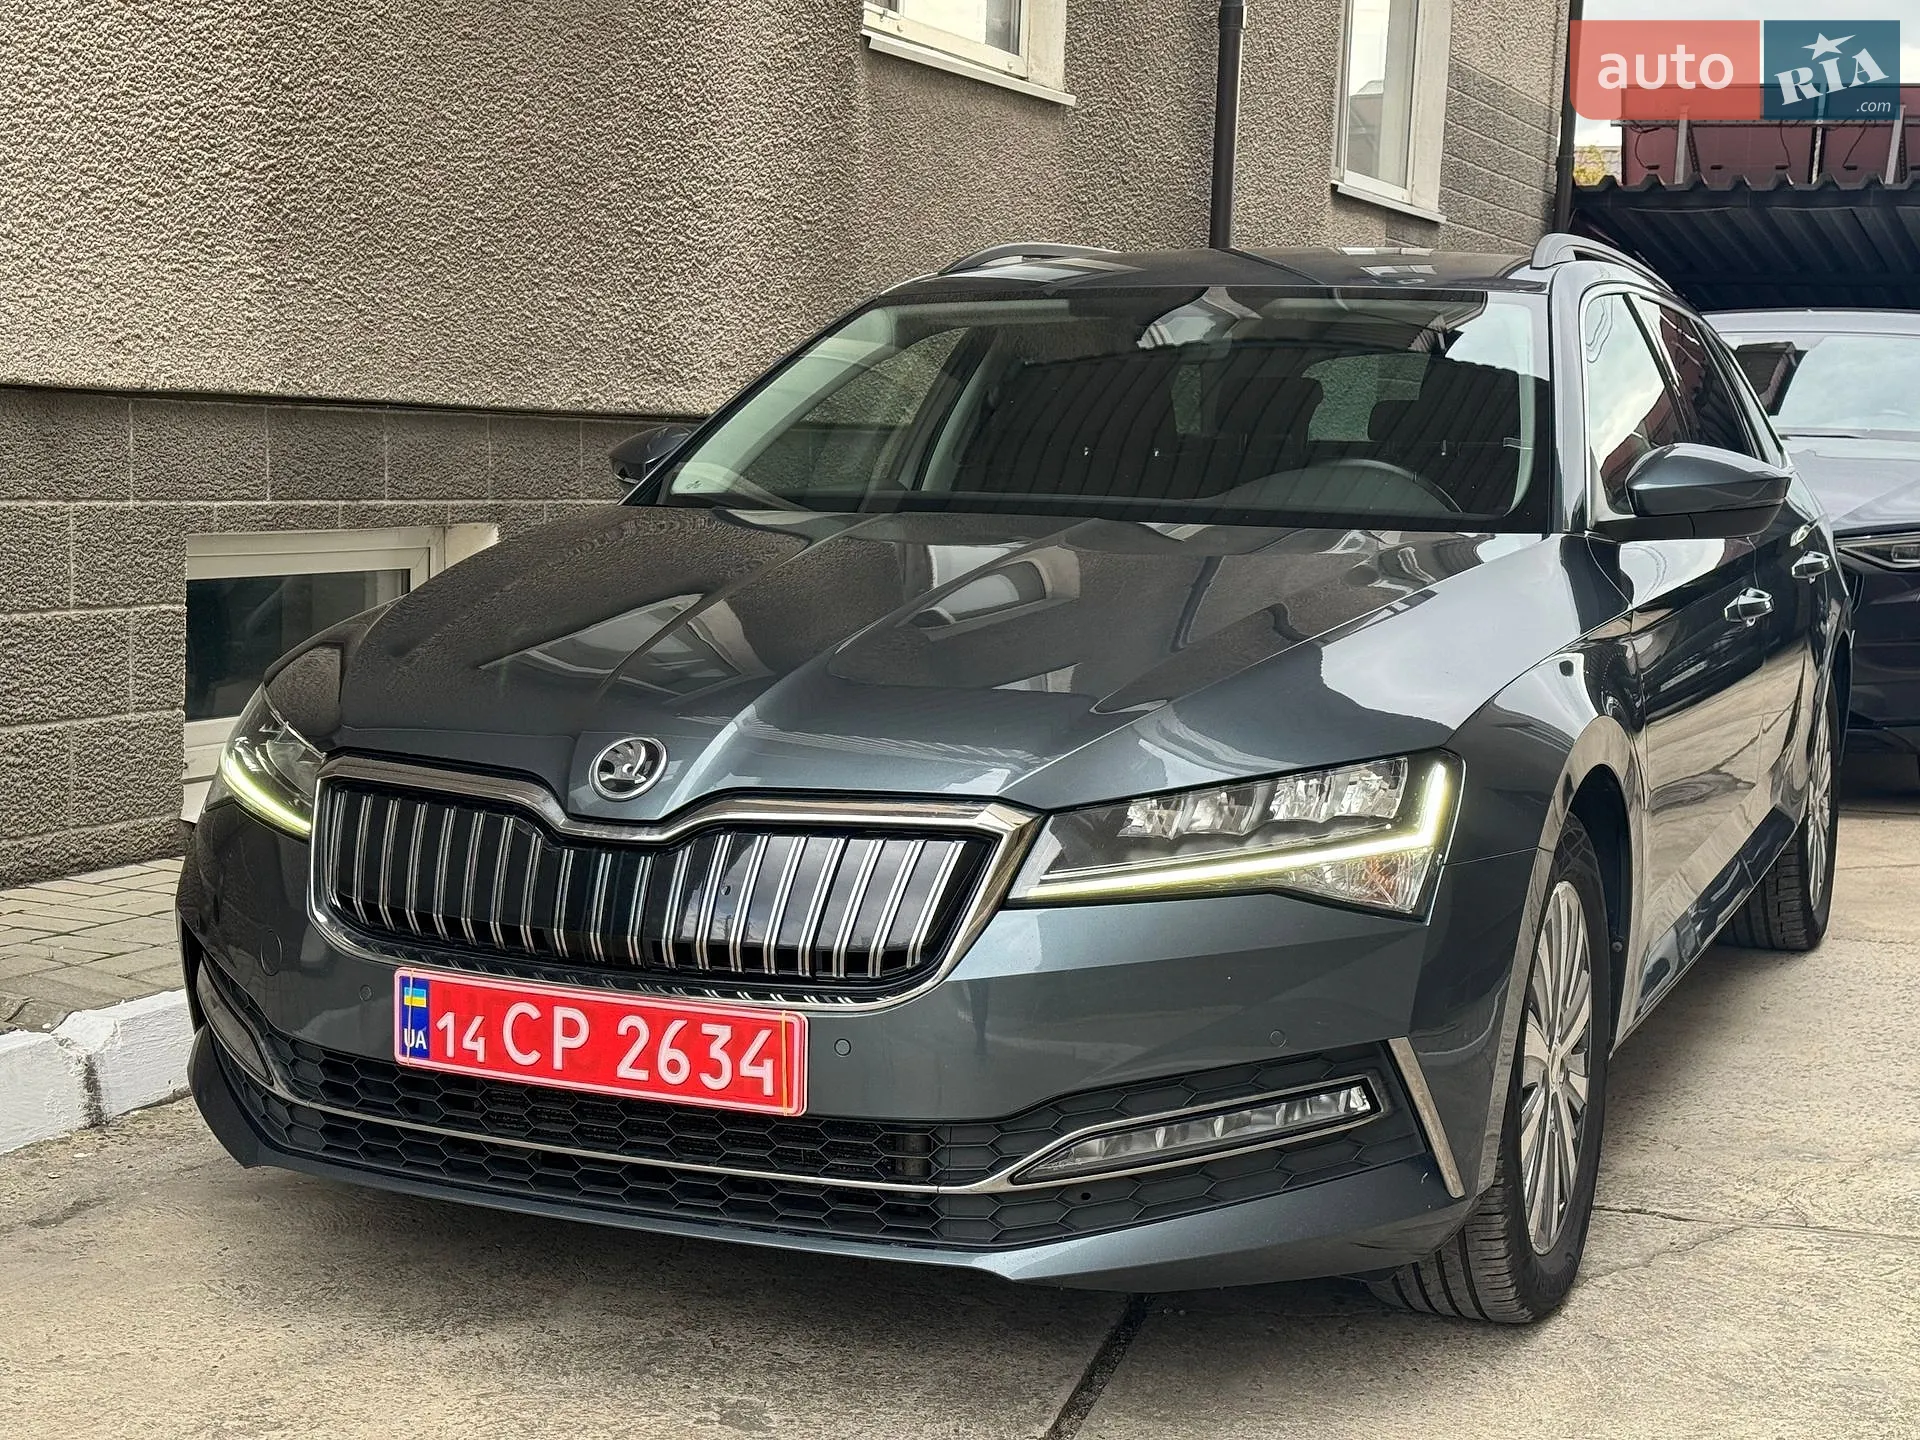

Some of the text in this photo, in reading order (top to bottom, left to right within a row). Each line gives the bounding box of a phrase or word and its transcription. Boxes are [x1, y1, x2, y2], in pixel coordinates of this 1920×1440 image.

[403, 1029, 428, 1050] UA
[436, 1002, 775, 1097] 14 CP 2634
